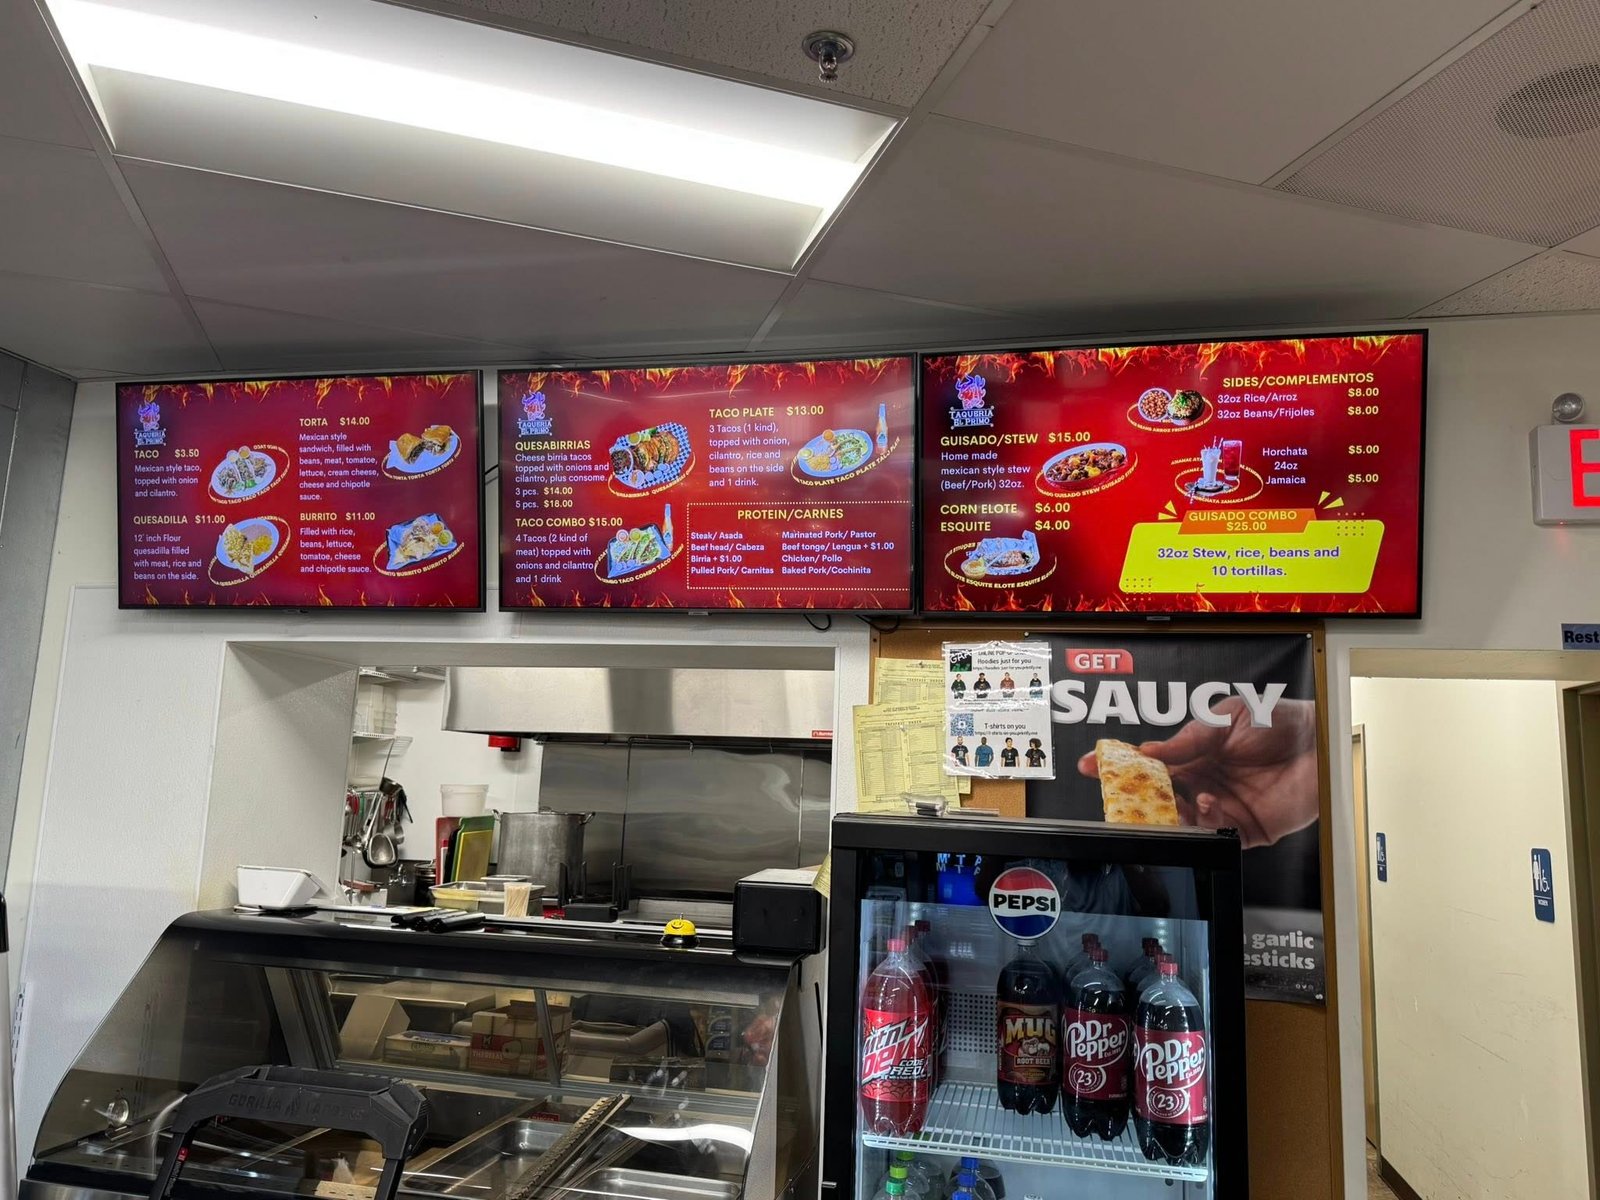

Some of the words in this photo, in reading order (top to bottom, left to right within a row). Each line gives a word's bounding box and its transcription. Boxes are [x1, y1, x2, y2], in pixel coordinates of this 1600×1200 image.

[1223, 372, 1374, 388] SIDES/COMPLEMENTOS
[1218, 394, 1240, 404] 32oz
[1244, 393, 1297, 403] Rice/Arroz
[1348, 388, 1379, 398] $8.00
[709, 409, 740, 418] TACO
[743, 408, 774, 417] PLATE
[787, 406, 824, 416] $13.00
[949, 410, 994, 419] TAQUERIA
[1218, 410, 1240, 419] 32oz
[1244, 408, 1315, 418] Beans/Frijoles
[1348, 406, 1379, 416] $8.00
[300, 418, 328, 427] TORTA
[340, 417, 370, 426] $14.00
[954, 418, 963, 426] EL
[966, 417, 990, 425] PRIMO
[709, 425, 714, 433] 3
[718, 425, 741, 433] Tacos
[744, 423, 751, 434] (1
[755, 423, 778, 433] kind),
[709, 438, 740, 448] topped
[742, 437, 760, 446] with
[763, 437, 790, 446] onion,
[941, 433, 1038, 446] GUISADO/STEW
[1048, 432, 1090, 443] $15.00
[515, 441, 591, 451] QUESABIRRIAS
[1262, 447, 1308, 457] Horchata
[1348, 445, 1380, 455] $5.00
[135, 450, 159, 459] TACO
[175, 449, 199, 458] $3.50
[516, 454, 545, 462] Cheese
[570, 453, 592, 461] tacos
[709, 451, 744, 461] cilantro,
[747, 451, 761, 459] rice
[764, 450, 781, 459] and
[942, 453, 969, 461] Home
[972, 452, 998, 460] made
[135, 465, 164, 473] Mexican
[166, 465, 182, 476] style
[516, 464, 544, 474] topped
[547, 464, 563, 472] with
[594, 463, 609, 471] and
[709, 465, 734, 473] beans
[750, 464, 764, 472] the
[766, 464, 784, 472] side
[942, 467, 979, 475] mexican
[983, 466, 1005, 476] style
[1008, 465, 1030, 474] stew
[1274, 461, 1298, 470] 24oz
[1570, 429, 1600, 508] E
[135, 477, 160, 487] topped
[162, 476, 177, 485] with
[516, 475, 548, 484] cilantro,
[550, 475, 567, 484] plus
[709, 478, 725, 486] and
[728, 478, 732, 486] 1
[735, 477, 759, 486] drink.
[941, 479, 996, 491] (Beef/Pork)
[999, 480, 1025, 489] 32oz.
[1266, 475, 1306, 485] Jamaica
[1348, 474, 1379, 483] $5.00
[150, 489, 178, 497] cilantro.
[523, 489, 539, 497] pcs.
[544, 487, 572, 495] $14.00
[523, 502, 539, 510] pcs.
[544, 500, 573, 508] $18.00
[941, 504, 977, 514] CORN
[982, 504, 1017, 514] ELOTE
[1035, 502, 1070, 513] $6.00
[134, 515, 188, 525] QUESADILLA
[195, 515, 225, 524] $11.00
[300, 513, 337, 521] BURRITO
[346, 512, 375, 521] $11.00
[738, 509, 843, 521] PROTEIN/CARNES
[1189, 511, 1245, 522] GUISADO
[1249, 510, 1297, 521] COMBO
[516, 519, 544, 527] TACO
[546, 518, 586, 527] COMBO
[589, 517, 623, 527] $15.00
[941, 522, 991, 532] ESQUITE
[1035, 520, 1070, 531] $4.00
[1227, 521, 1267, 532] $25.00
[825, 531, 848, 539] Pork/
[516, 548, 539, 557] meat)
[541, 548, 572, 557] topped
[575, 548, 591, 556] with
[710, 544, 734, 552] head/
[802, 543, 829, 553] tonge/
[832, 543, 861, 552] Lengua
[870, 542, 894, 550] $1.00
[720, 555, 742, 563] $1.00
[782, 555, 820, 563] Chicken/
[1158, 548, 1189, 559] 32oz
[1193, 548, 1231, 560] Stew,
[1236, 548, 1265, 560] rice,
[1270, 547, 1310, 558] beans
[1314, 547, 1339, 558] and
[717, 567, 739, 575] Pork/
[808, 566, 871, 575] Pork/Cochinita
[1212, 566, 1227, 576] 10
[1232, 566, 1287, 577] tortillas.
[1074, 653, 1121, 669] GET
[1051, 680, 1288, 728] SAUCY
[994, 894, 1056, 912] PEPSI
[1252, 930, 1314, 949] garlic
[1006, 1018, 1056, 1046] MUG
[1086, 1020, 1112, 1040] Dr
[1067, 1023, 1126, 1062] Pepper
[1165, 1039, 1192, 1058] Dr
[1141, 1044, 1205, 1084] Pepper
[890, 1067, 921, 1075] RED
[1077, 1070, 1092, 1085] 23
[1158, 1094, 1174, 1110] 23
